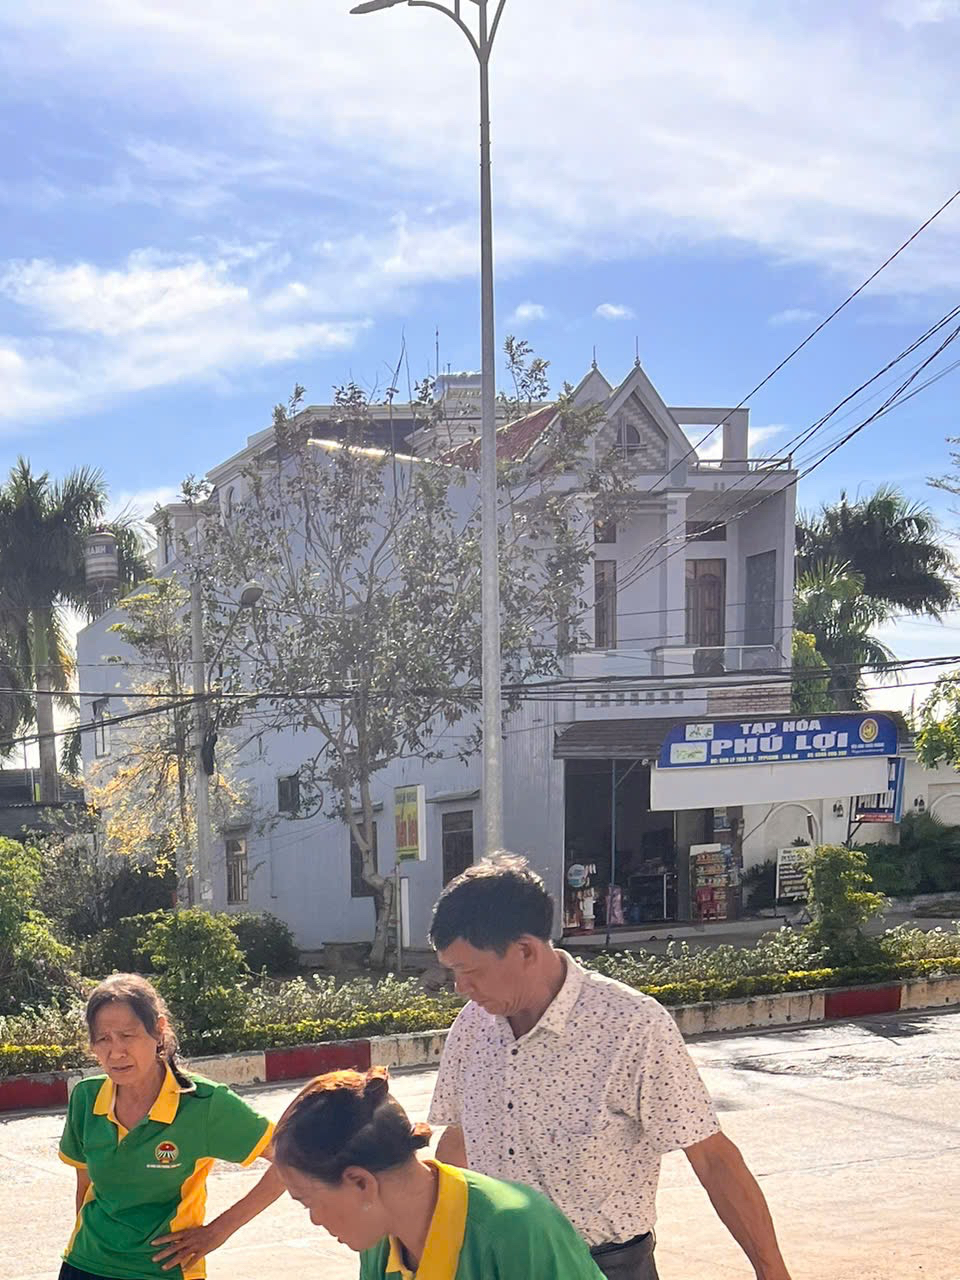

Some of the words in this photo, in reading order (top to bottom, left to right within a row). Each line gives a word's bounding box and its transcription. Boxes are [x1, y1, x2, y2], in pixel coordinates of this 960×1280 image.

[740, 722, 777, 736] TẠP
[782, 718, 821, 732] HÓA
[711, 734, 783, 755] PHÚ
[795, 731, 848, 751] LỢI
